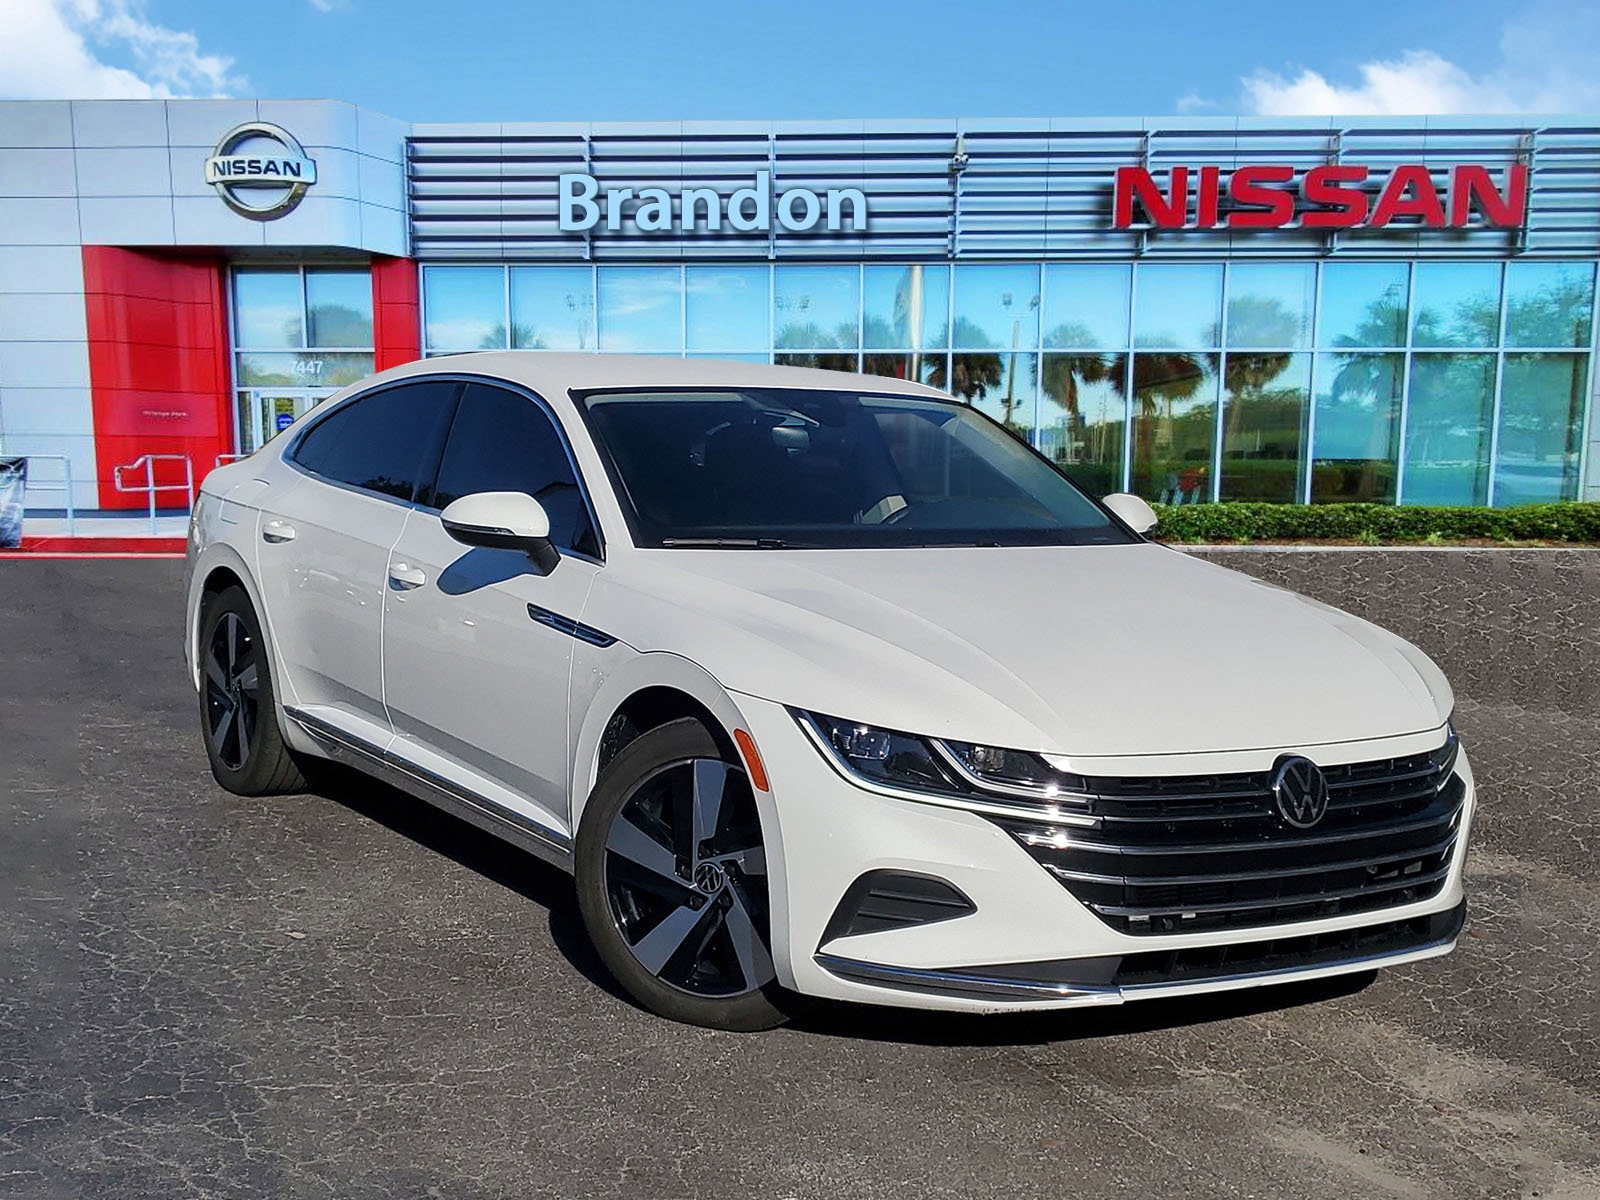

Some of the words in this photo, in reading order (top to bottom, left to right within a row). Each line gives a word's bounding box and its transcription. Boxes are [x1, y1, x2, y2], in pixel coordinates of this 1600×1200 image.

[213, 159, 301, 177] NISSAN
[1113, 164, 1528, 229] NISSAN
[559, 170, 867, 232] Brandon
